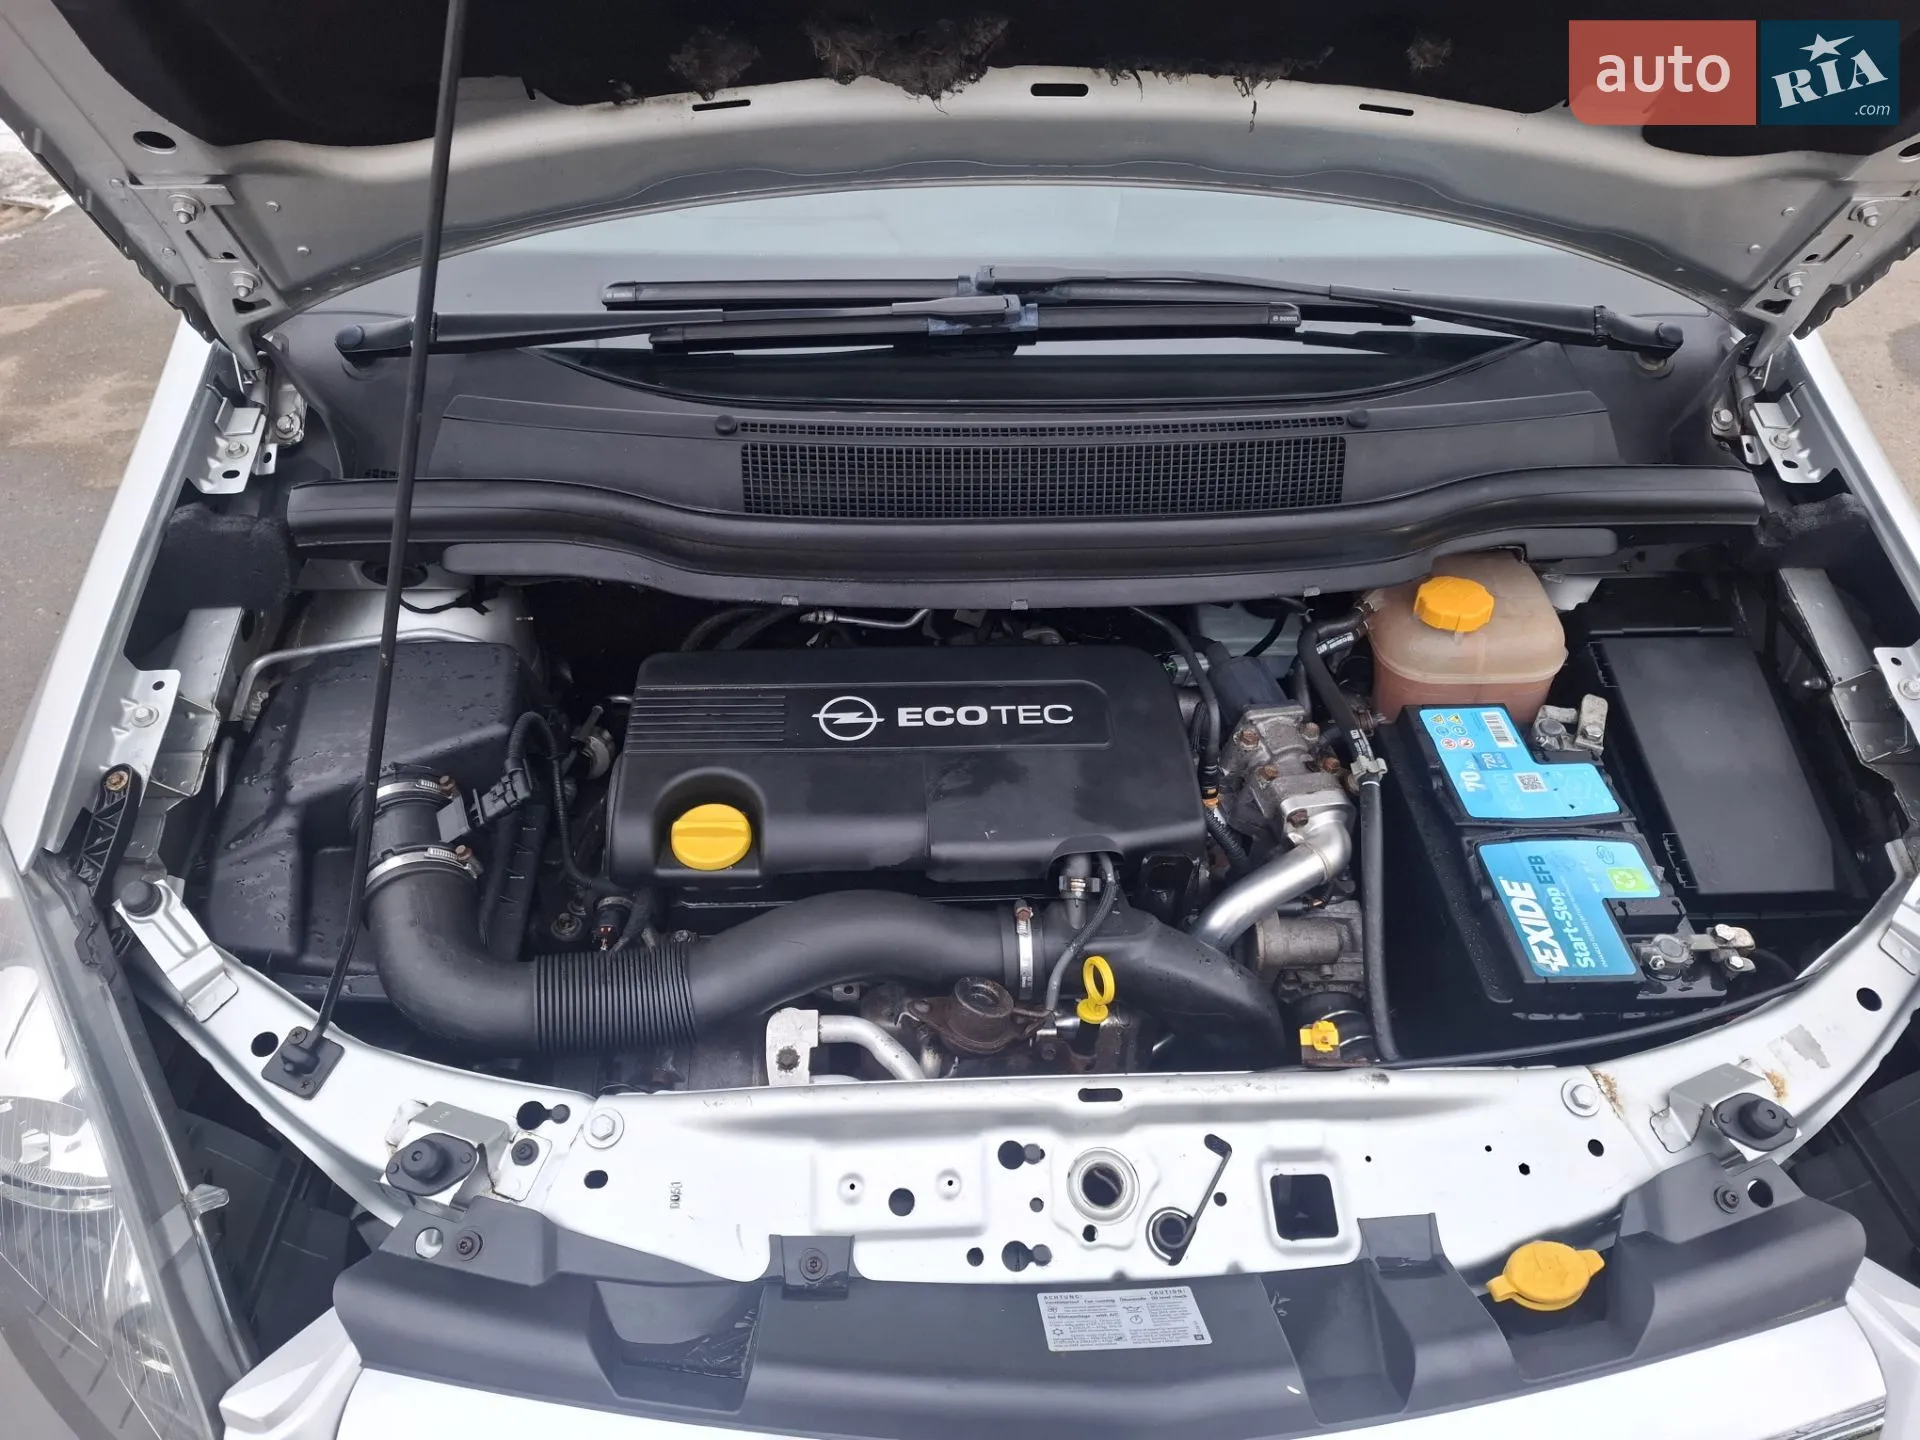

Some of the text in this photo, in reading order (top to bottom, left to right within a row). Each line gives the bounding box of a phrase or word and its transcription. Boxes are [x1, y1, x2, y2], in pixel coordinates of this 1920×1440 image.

[898, 704, 1074, 727] ECOTEC
[1481, 753, 1499, 769] 720
[1460, 771, 1487, 792] 70
[1528, 855, 1555, 885] EFB
[1500, 879, 1569, 972] EXIDE
[1546, 887, 1595, 968] Start-Stop
